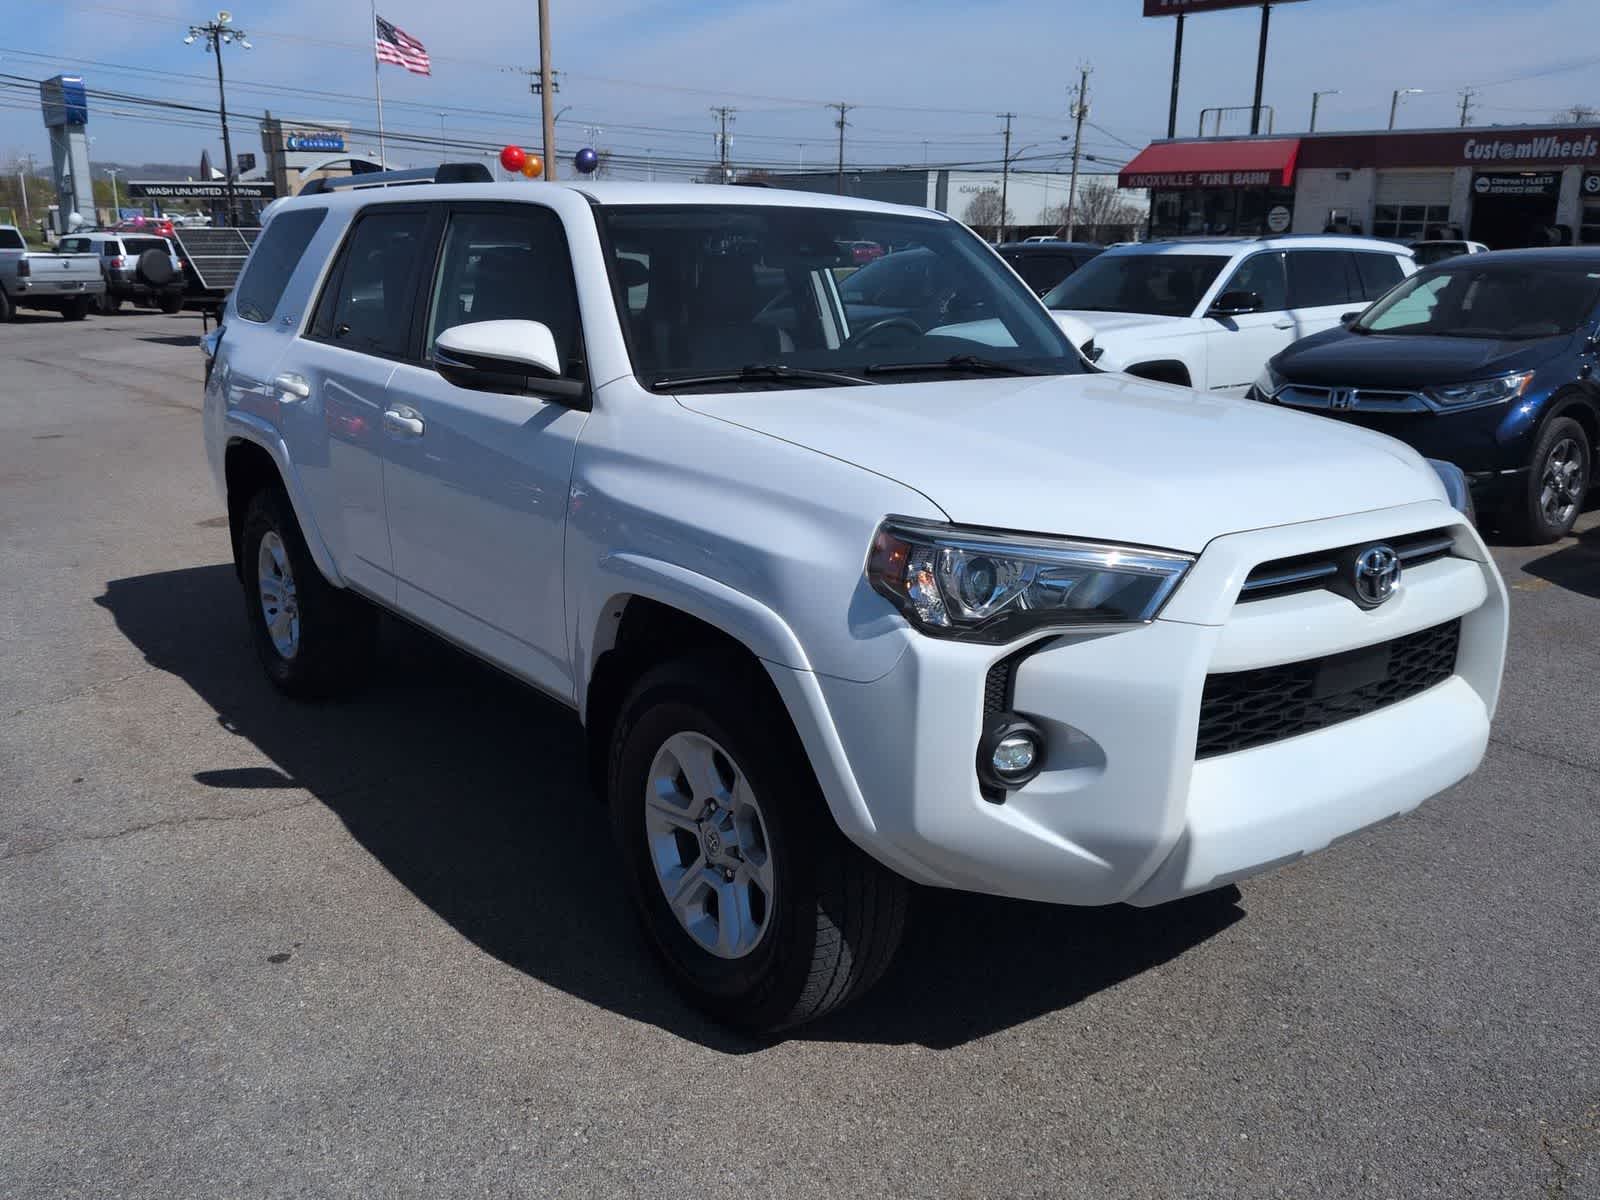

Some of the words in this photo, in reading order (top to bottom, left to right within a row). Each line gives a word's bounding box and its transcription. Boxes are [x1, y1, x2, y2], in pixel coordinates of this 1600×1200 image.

[1128, 173, 1193, 187] KNOXVILLE
[1199, 172, 1230, 185] TIRE
[1233, 171, 1270, 185] BARN
[145, 187, 174, 196] WASH
[175, 187, 222, 196] UNLIMITED
